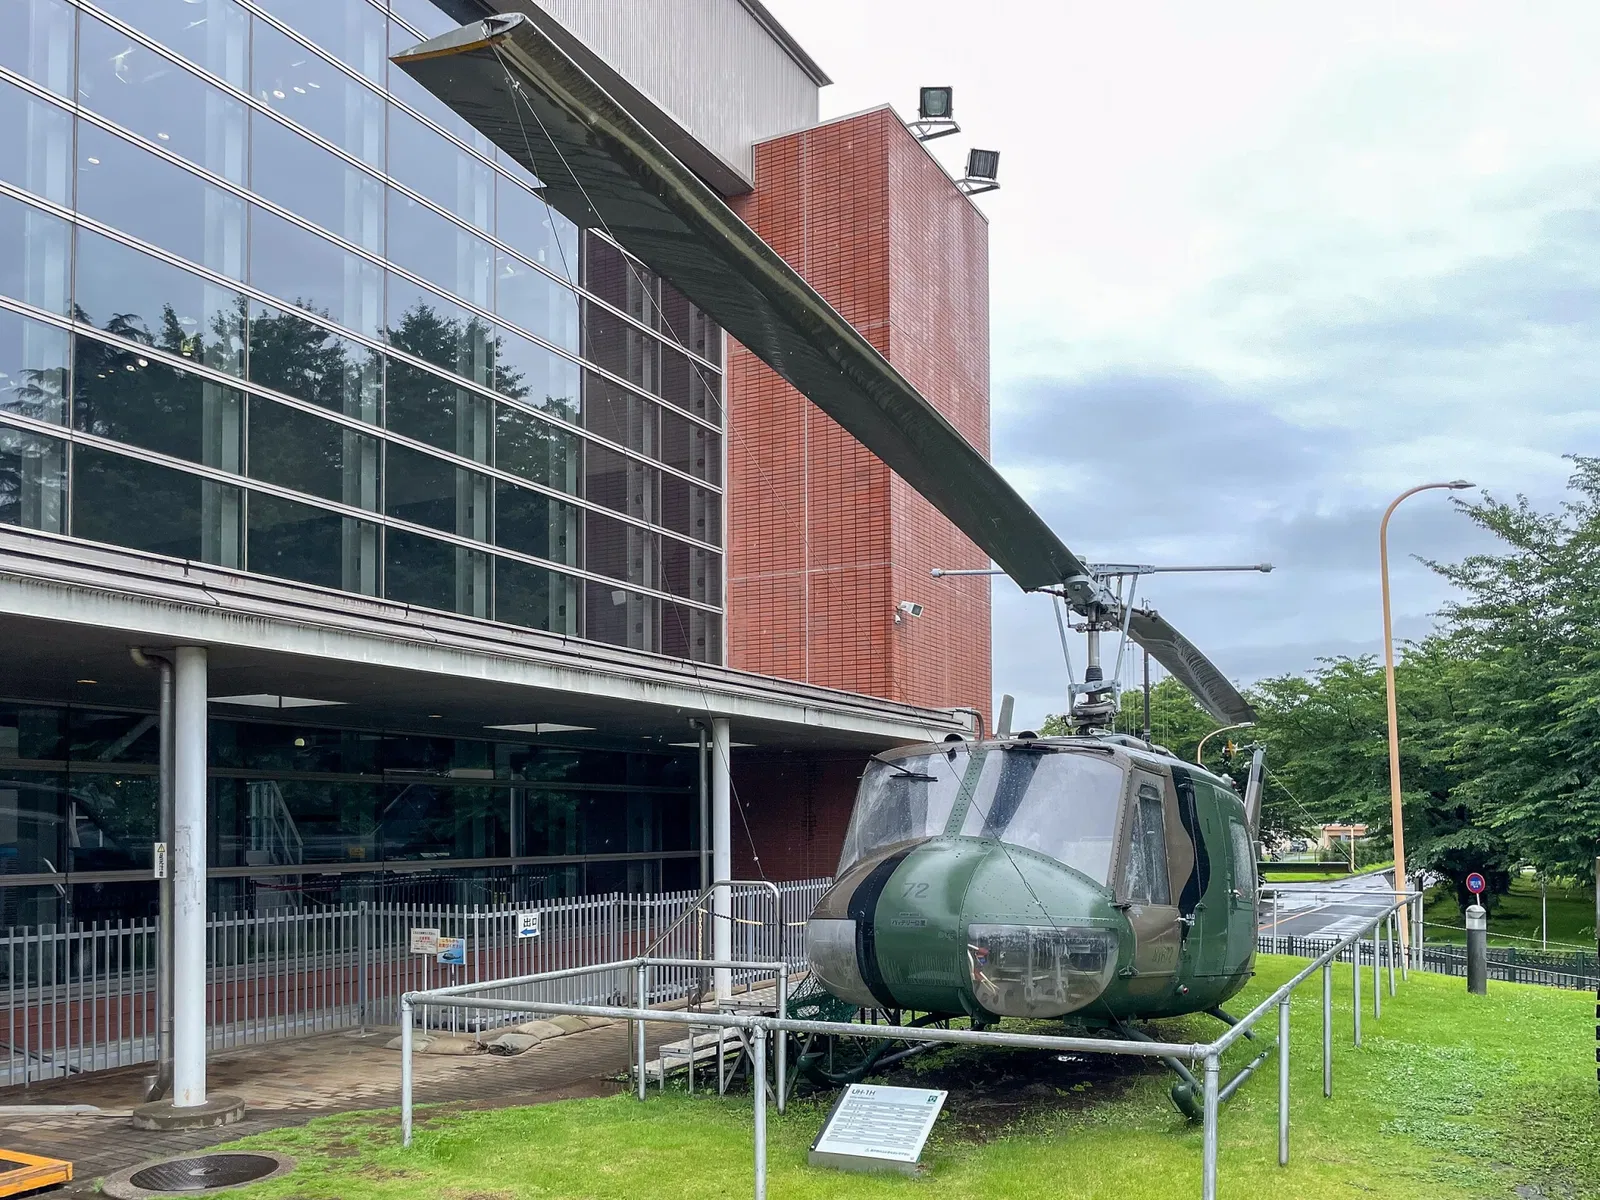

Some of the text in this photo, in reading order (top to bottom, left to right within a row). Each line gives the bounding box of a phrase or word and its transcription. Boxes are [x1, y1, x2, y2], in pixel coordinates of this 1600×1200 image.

[902, 882, 930, 899] 72
[523, 917, 537, 928] 出口
[851, 1088, 876, 1096] UH-1H
